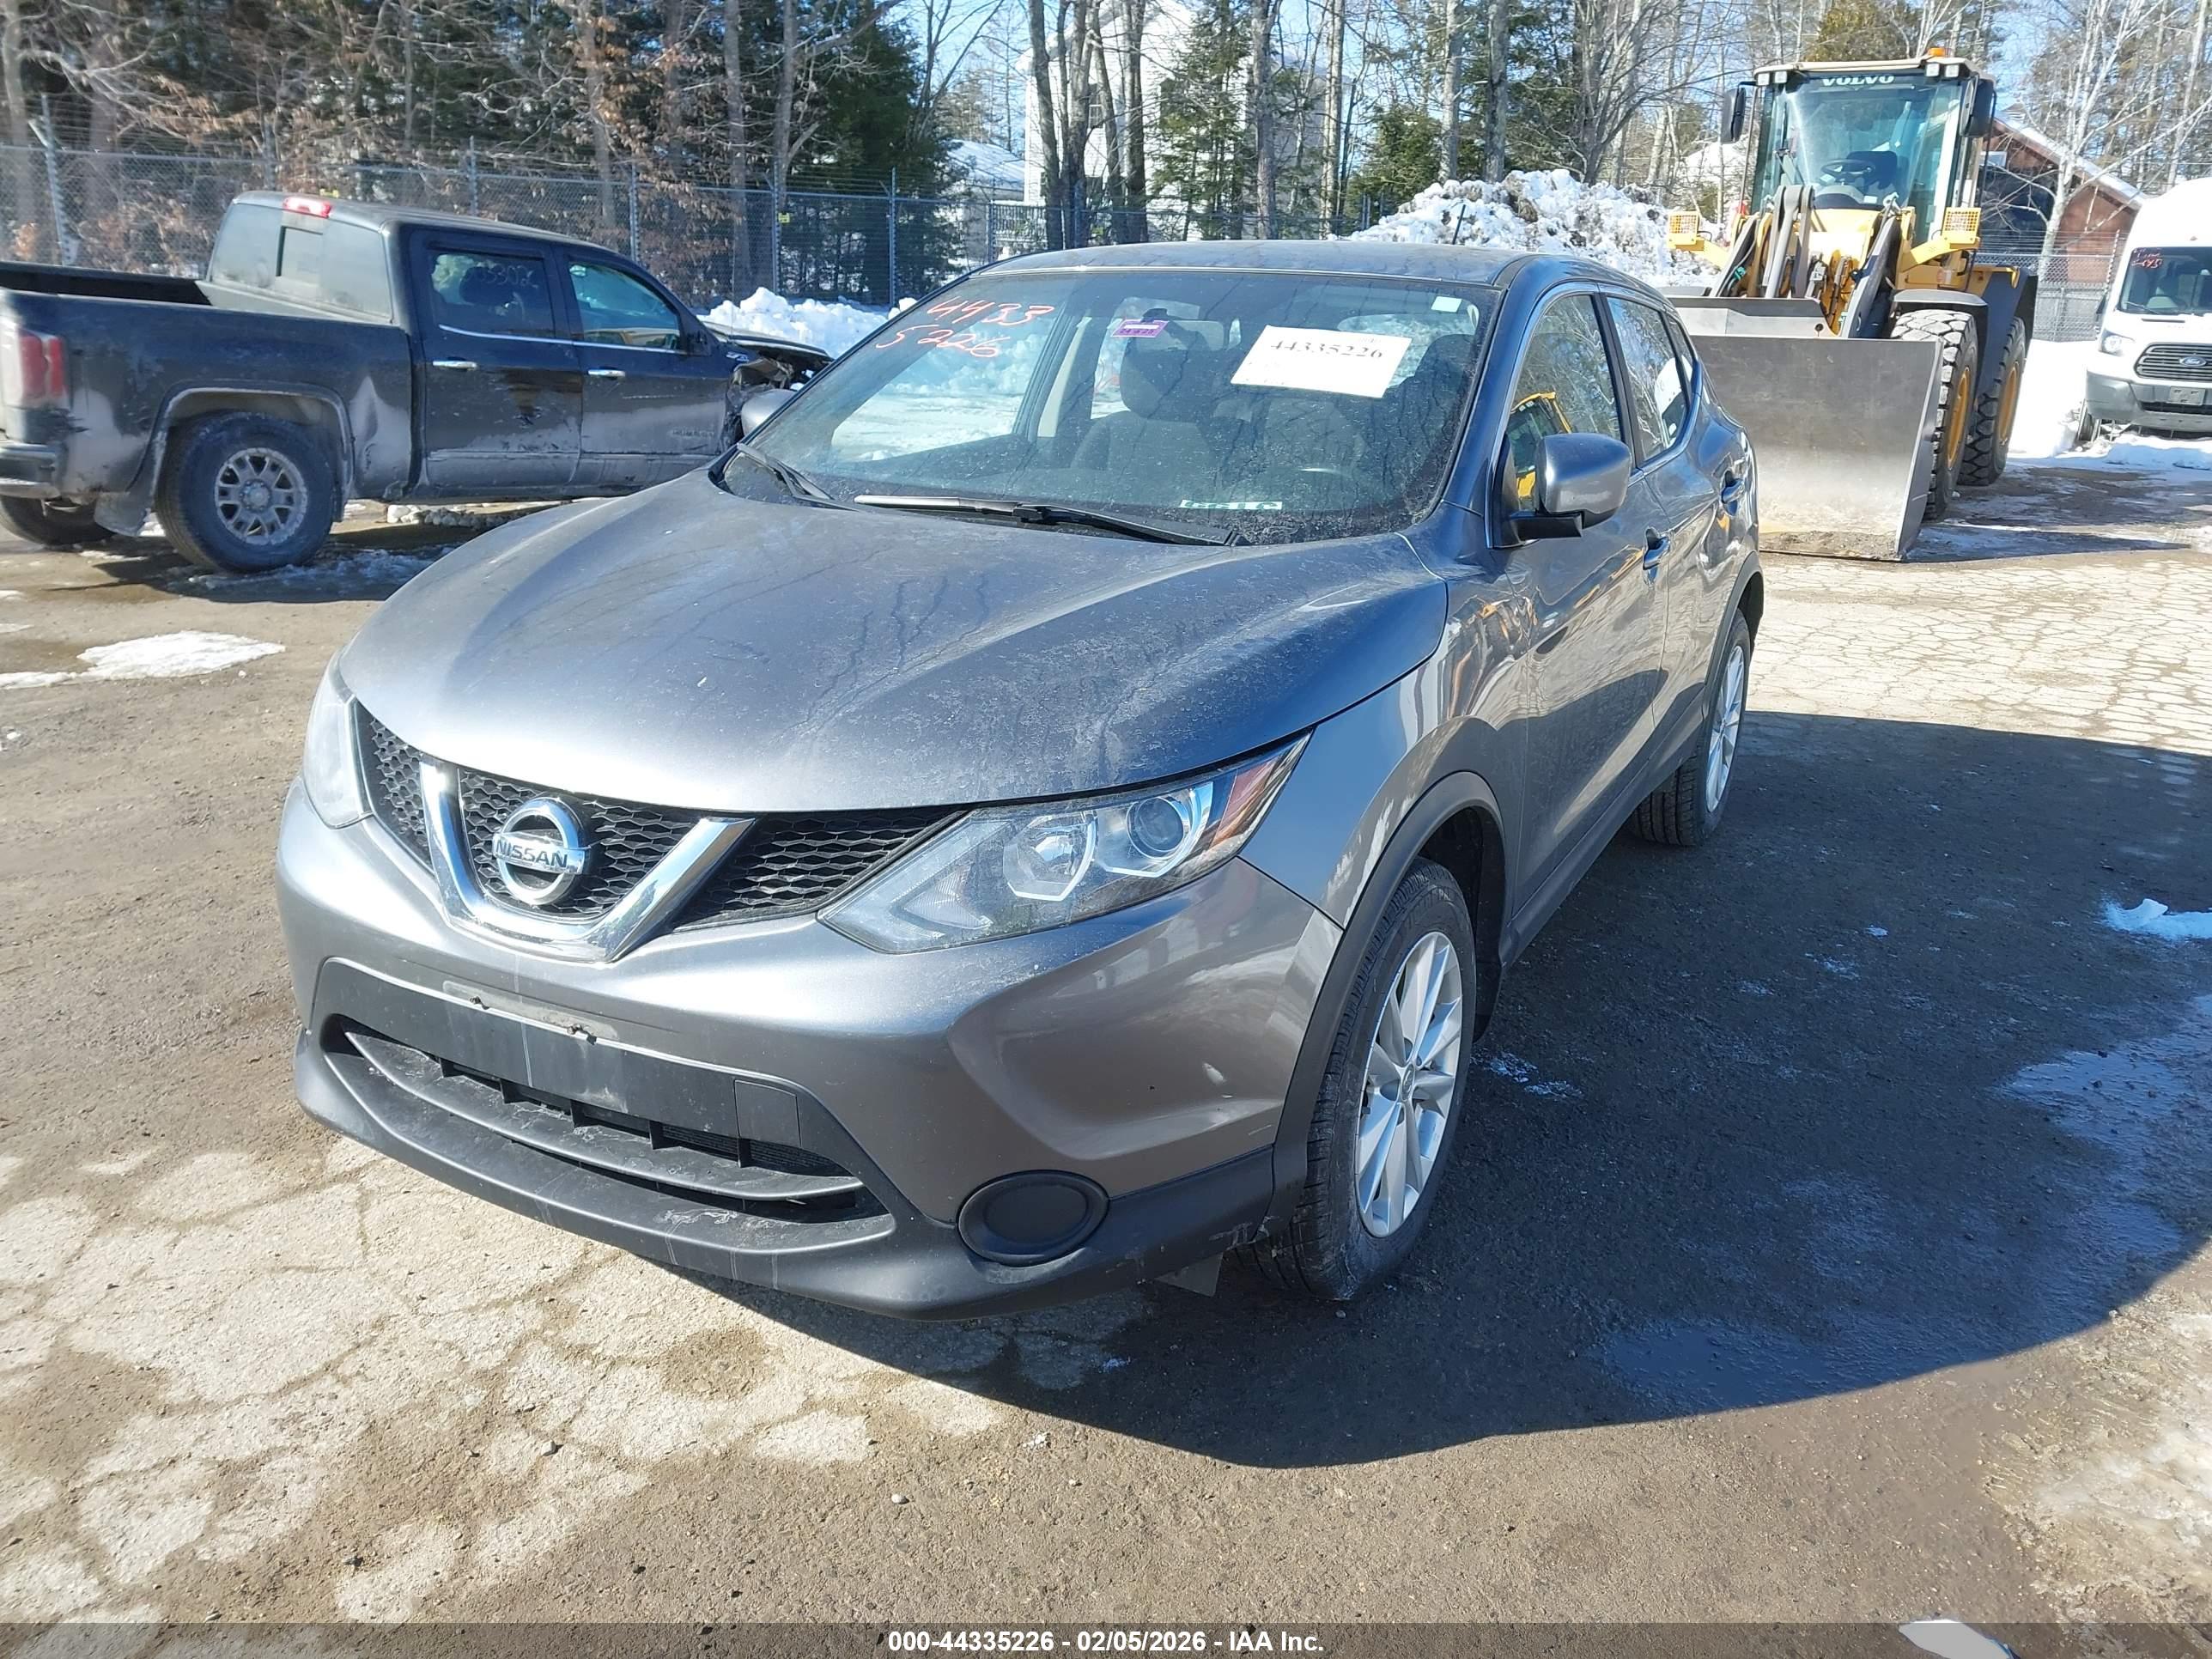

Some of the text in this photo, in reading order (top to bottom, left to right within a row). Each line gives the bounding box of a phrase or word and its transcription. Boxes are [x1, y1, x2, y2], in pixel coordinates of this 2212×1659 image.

[1822, 75, 1894, 87] VOLVO
[875, 324, 1011, 357] 5226
[1270, 339, 1382, 359] 44335226
[495, 838, 568, 868] NISSAN
